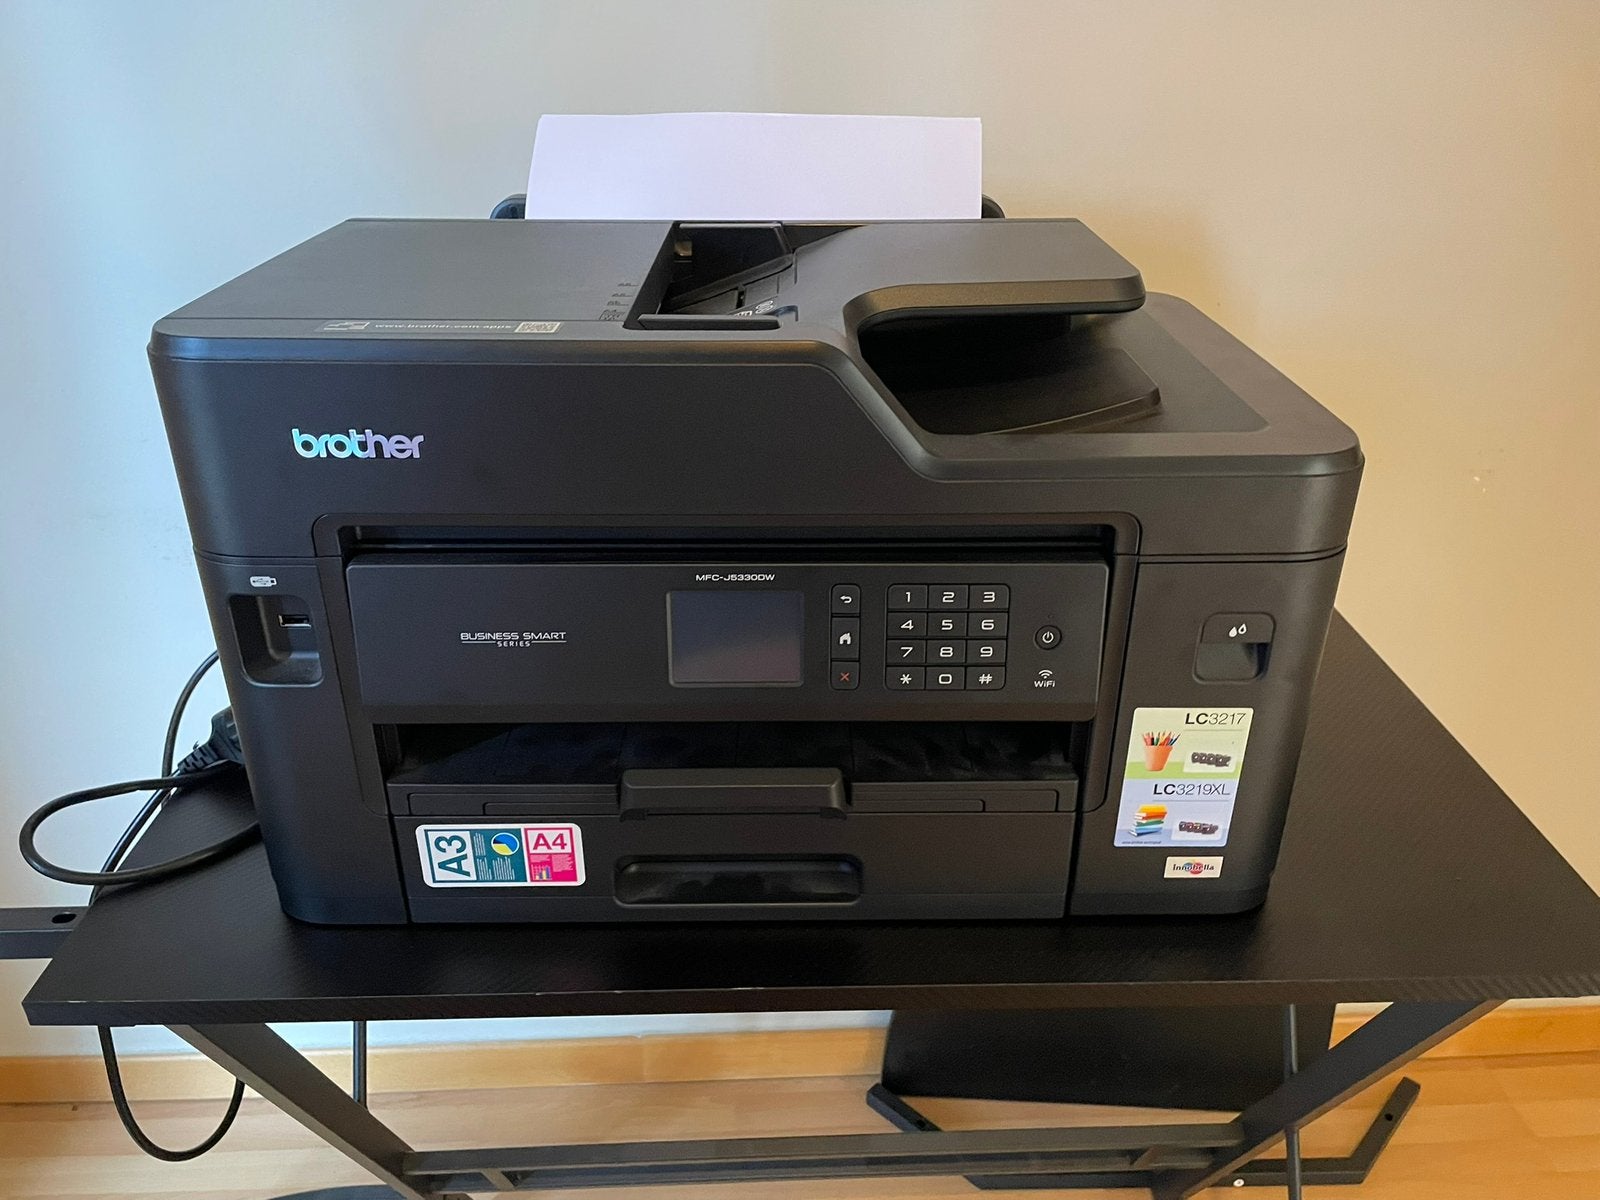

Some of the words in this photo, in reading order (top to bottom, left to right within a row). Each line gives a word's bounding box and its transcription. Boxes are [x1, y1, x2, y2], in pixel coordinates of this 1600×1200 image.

[291, 427, 425, 459] brother
[695, 573, 776, 582] MFC-J5330DW
[905, 591, 911, 603] 1
[942, 591, 955, 603] 2
[983, 591, 996, 603] 3
[900, 619, 914, 631] 4
[941, 619, 953, 631] 5
[981, 619, 995, 631] 6
[460, 632, 519, 641] BUSINESS
[522, 631, 567, 640] SMART
[496, 640, 531, 648] SERIES
[900, 646, 914, 658] 7
[939, 646, 954, 658] 8
[980, 646, 993, 658] 9
[938, 673, 953, 685] 0
[978, 673, 993, 685] #
[1034, 679, 1056, 688] WiFi
[1184, 712, 1247, 725] LC3217
[1152, 783, 1231, 796] LC3219XL
[532, 832, 568, 850] A4
[434, 834, 471, 878] A3
[1172, 863, 1215, 871] Innobella
